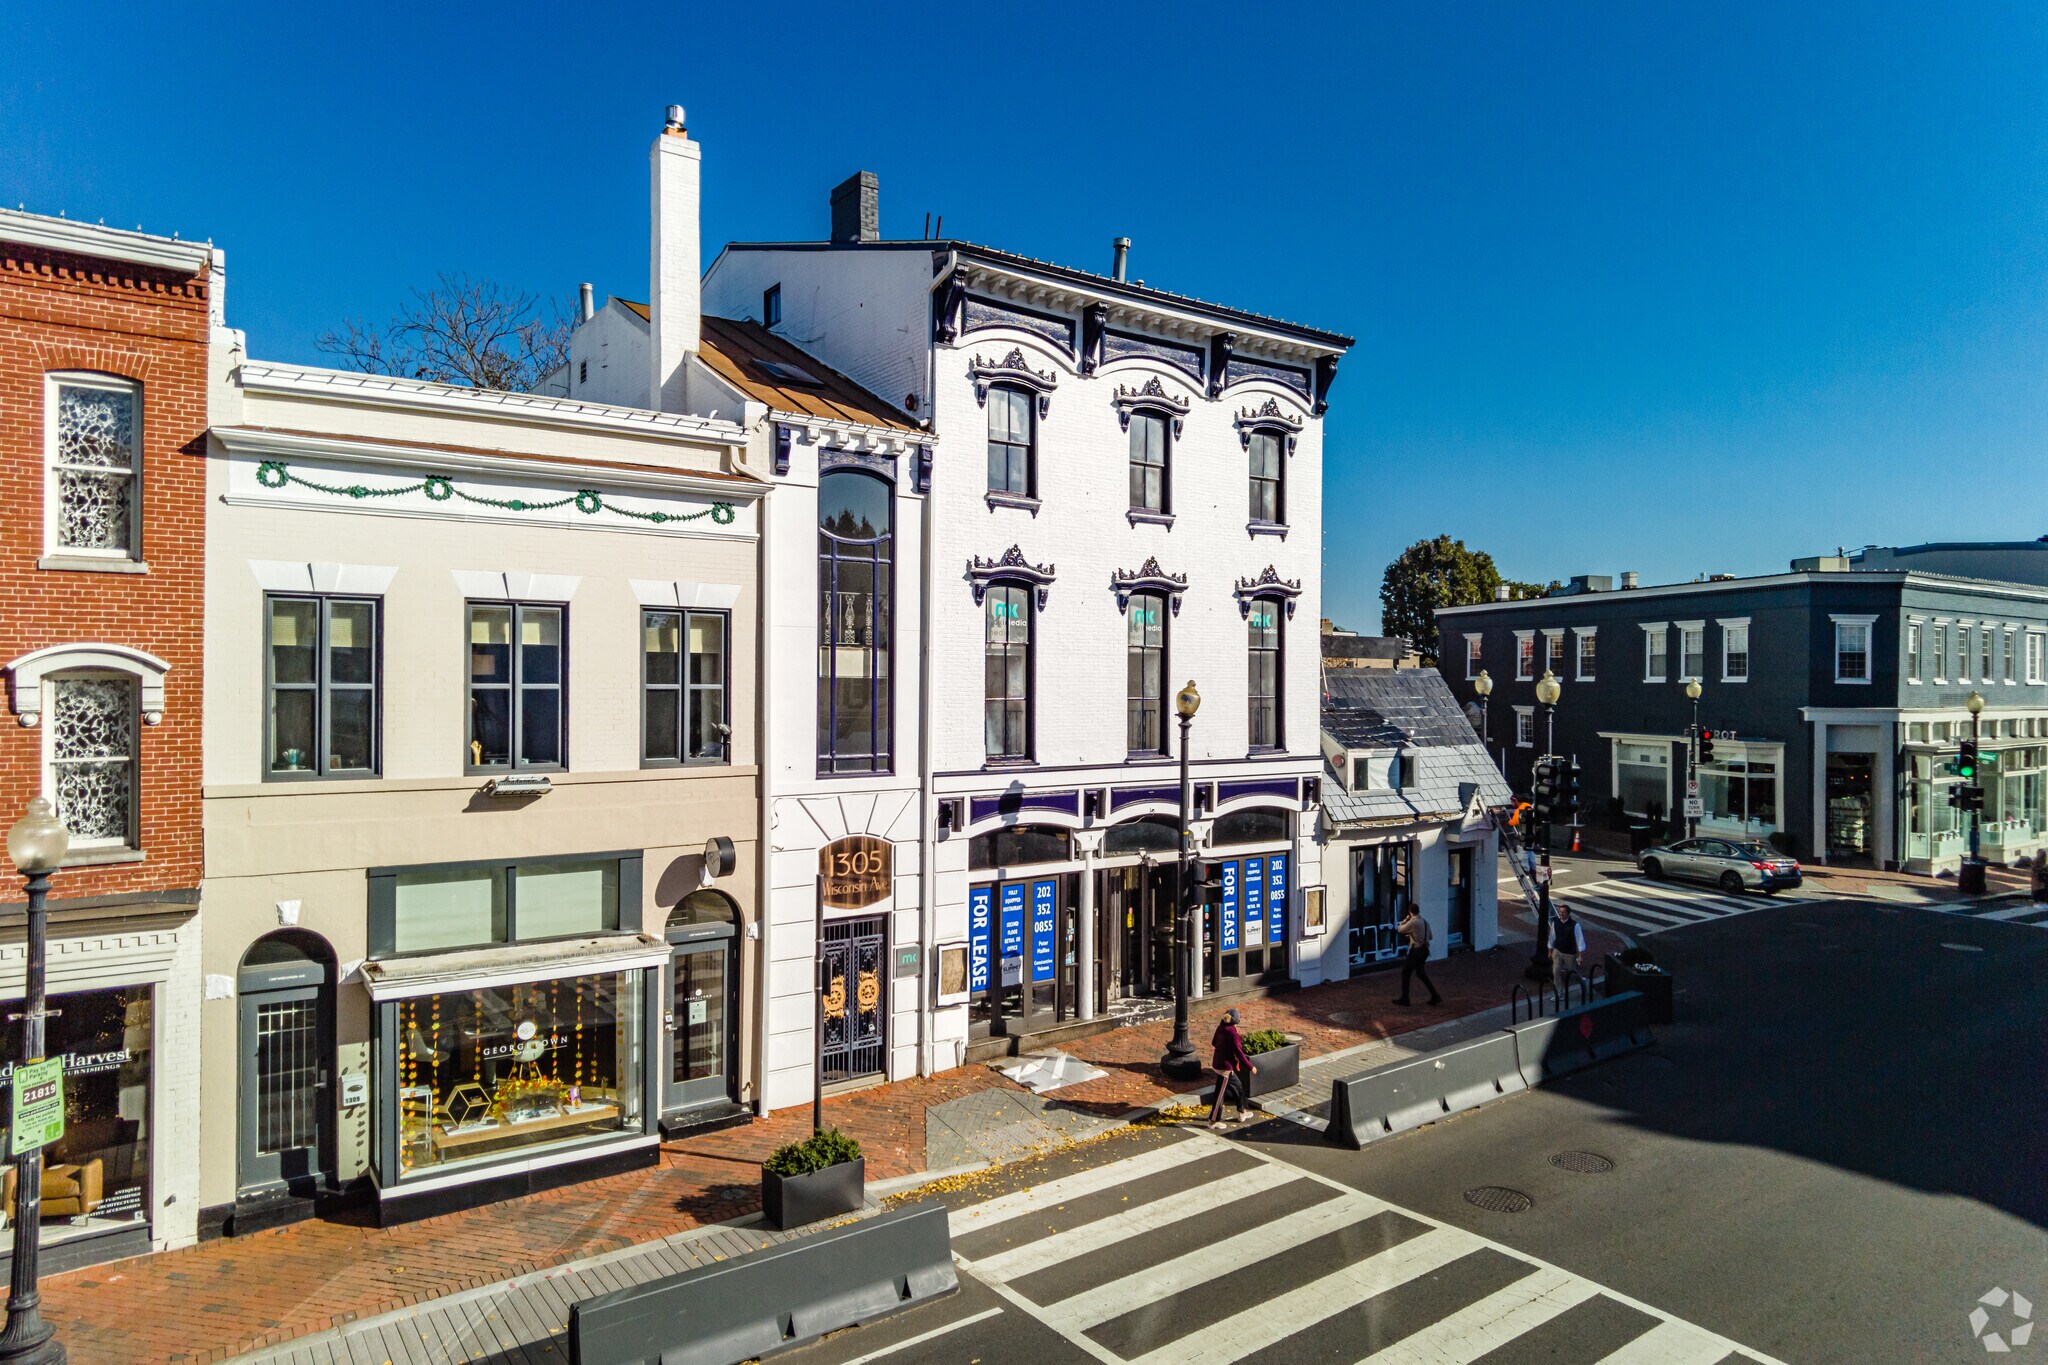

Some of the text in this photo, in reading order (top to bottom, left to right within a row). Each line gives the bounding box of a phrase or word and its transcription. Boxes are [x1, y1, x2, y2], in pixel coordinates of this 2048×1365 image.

[830, 850, 882, 878] 1305
[1272, 860, 1283, 871] 202
[1272, 875, 1283, 886] 352
[823, 880, 867, 896] Wisconsin
[1036, 885, 1051, 899] 202
[1270, 889, 1285, 900] 0855
[1036, 902, 1051, 916] 352
[1224, 867, 1235, 947] FOR LEASE
[1034, 919, 1053, 933] 0855
[972, 895, 988, 988] FOR LEASE
[62, 1047, 132, 1069] Harvest
[62, 1064, 121, 1077] FURNISHINGS
[23, 1083, 56, 1103] 21819
[114, 1186, 141, 1195] ANTIQUES
[97, 1198, 141, 1210] ARCHITECTURAL
